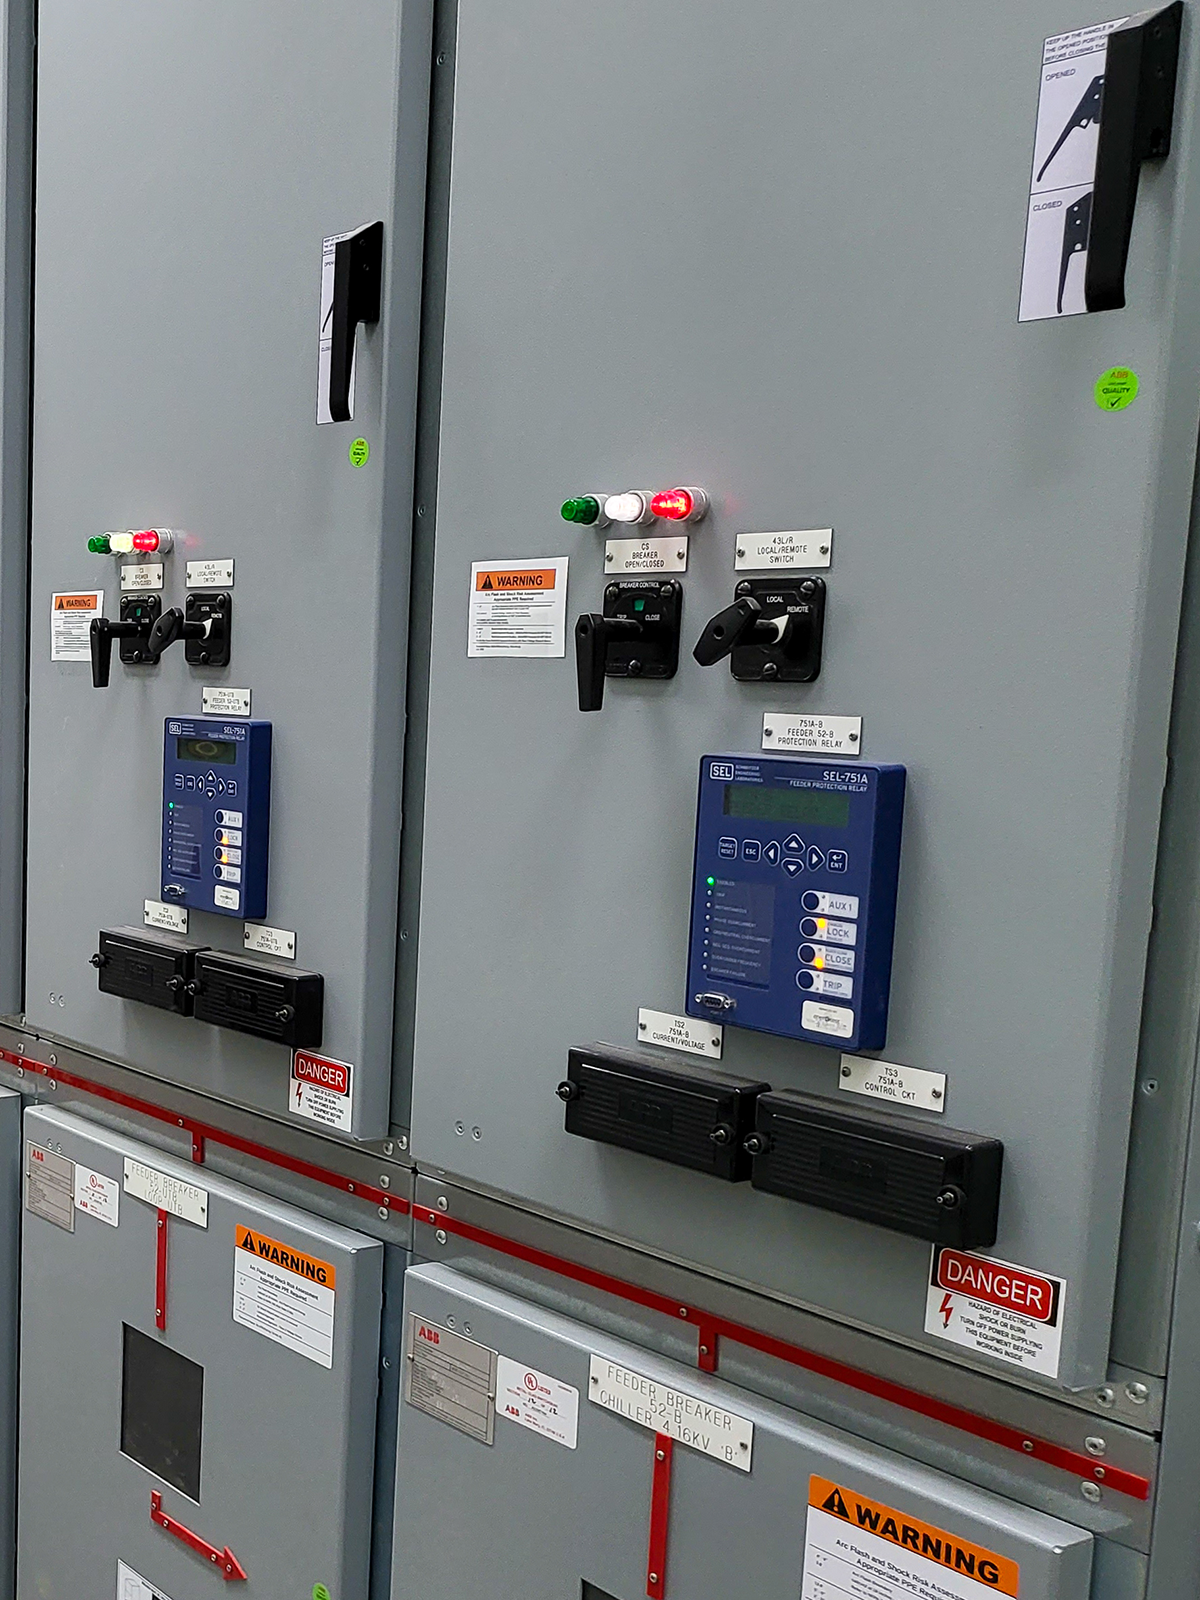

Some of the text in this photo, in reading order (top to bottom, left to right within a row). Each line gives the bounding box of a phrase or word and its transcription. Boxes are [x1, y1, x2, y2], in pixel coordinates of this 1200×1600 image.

[1046, 36, 1060, 46] KEEP
[1061, 34, 1070, 42] UP
[1071, 30, 1083, 40] THE
[1083, 26, 1106, 36] HANDLE
[1046, 34, 1108, 54] THE OPENED POSITIO
[1045, 42, 1106, 62] BEFORE CLOSING THE
[1045, 68, 1076, 81] OPENED
[1033, 200, 1063, 212] CLOSED
[1111, 370, 1128, 379] ABB
[1102, 386, 1131, 395] QUALITY
[772, 537, 794, 545] 43L/R
[632, 551, 658, 560] BREAKER
[757, 545, 808, 555] LOCAL/REMOTE
[625, 560, 665, 569] OPEN/CLOSED
[769, 555, 794, 563] SWITCH
[497, 575, 543, 587] WARNING
[66, 598, 90, 608] WARNING
[787, 605, 809, 613] REMOTE
[170, 724, 179, 732] SEL
[799, 719, 823, 728] 751A-B
[223, 727, 245, 735] SEL-751A
[787, 728, 834, 738] FEEDER 52-B
[777, 737, 843, 748] PROTECTION RELAY
[712, 766, 732, 778] SEL
[823, 771, 868, 784] SEL-751A
[790, 780, 867, 792] FEEDER PROTECTION RELAY
[746, 848, 756, 856] ESC
[829, 900, 847, 910] AUX
[827, 928, 849, 938] LOCK
[825, 954, 852, 965] CLOSE
[823, 979, 843, 990] TRIP
[674, 1020, 685, 1028] TS2
[669, 1027, 689, 1038] 751A-B
[652, 1032, 705, 1050] CURRENT/VOLTAGE
[298, 1058, 343, 1088] DANGER
[884, 1067, 899, 1077] TS3
[878, 1076, 903, 1088] 751A-B
[864, 1082, 916, 1101] CONTROL CKT
[32, 1149, 44, 1161] ABB
[132, 1163, 199, 1200] FEEDER BREAKER
[145, 1189, 162, 1205] LOOP
[80, 1200, 88, 1208] ABB
[258, 1240, 327, 1283] WARNING
[947, 1258, 1043, 1310] DANGER
[968, 1301, 991, 1314] HAZARD
[1002, 1312, 1038, 1330] ELECTRICAL
[979, 1313, 999, 1325] SHOCK
[1009, 1323, 1026, 1335] BURN
[419, 1326, 439, 1345] ABB
[960, 1315, 1043, 1350] TURN OFF POWER SUPPLYING
[965, 1327, 1037, 1357] THIS EQUIPMENT BEFORE
[976, 1340, 1023, 1362] WORKING INSIDE
[607, 1366, 732, 1431] FEEDER BREAKER
[505, 1404, 520, 1417] ABB
[650, 1399, 682, 1424] 52-B
[600, 1389, 710, 1450] CHILLER 4.16KV
[856, 1503, 999, 1585] WARNING
[836, 1539, 929, 1587] Arc Flash and Shock Risk
[856, 1558, 900, 1583] Appropriate
[901, 1579, 918, 1591] PPE
